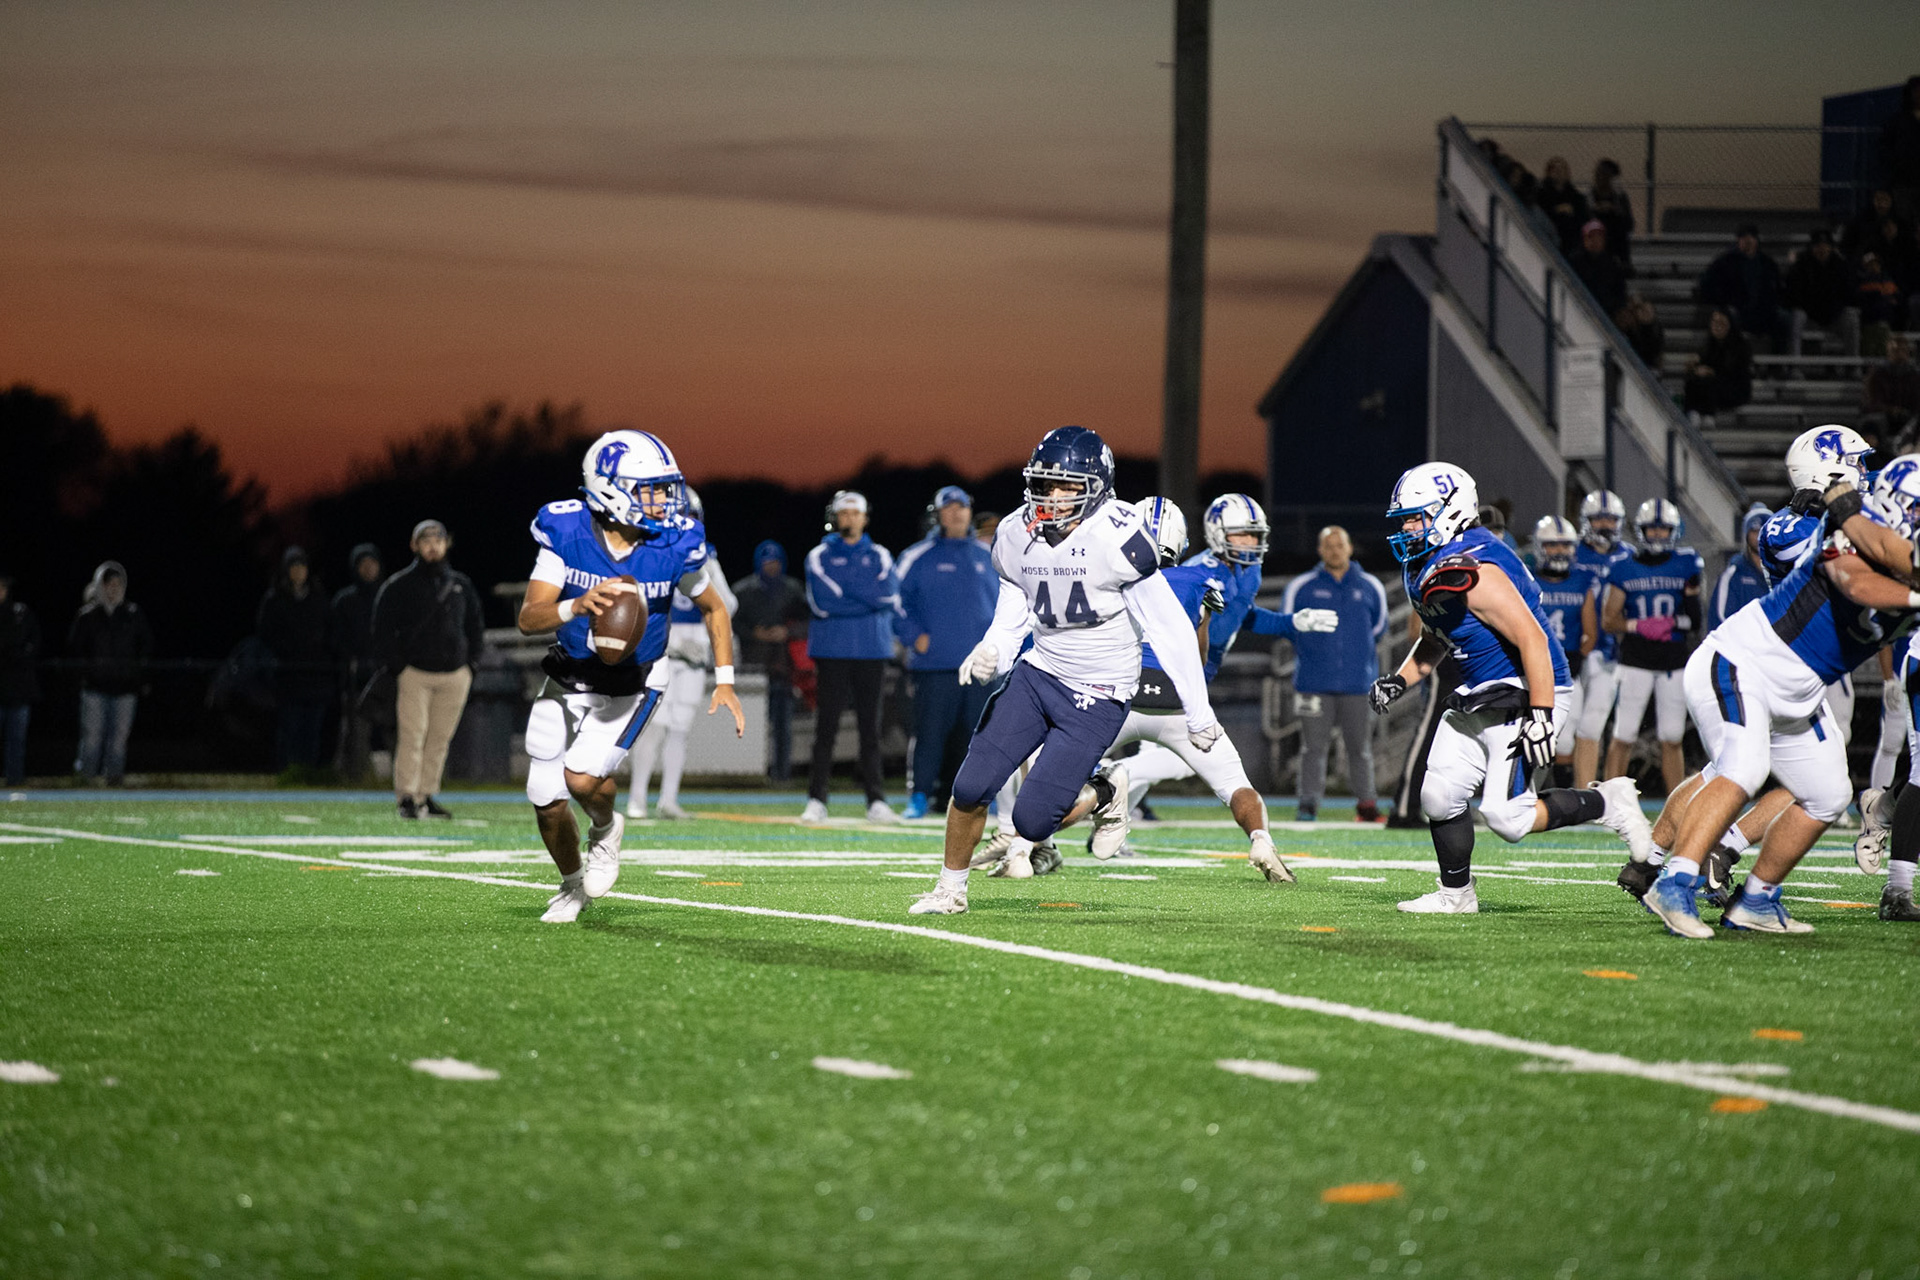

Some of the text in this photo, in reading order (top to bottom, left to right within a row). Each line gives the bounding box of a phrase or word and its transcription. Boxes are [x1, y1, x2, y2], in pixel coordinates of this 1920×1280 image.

[1432, 474, 1455, 494] 51
[547, 498, 583, 515] 8
[1108, 505, 1136, 528] 44
[565, 565, 672, 599] MIDDOWN
[1021, 566, 1087, 576] MOSES BROWN
[1033, 581, 1099, 629] 44
[1636, 593, 1675, 620] 10
